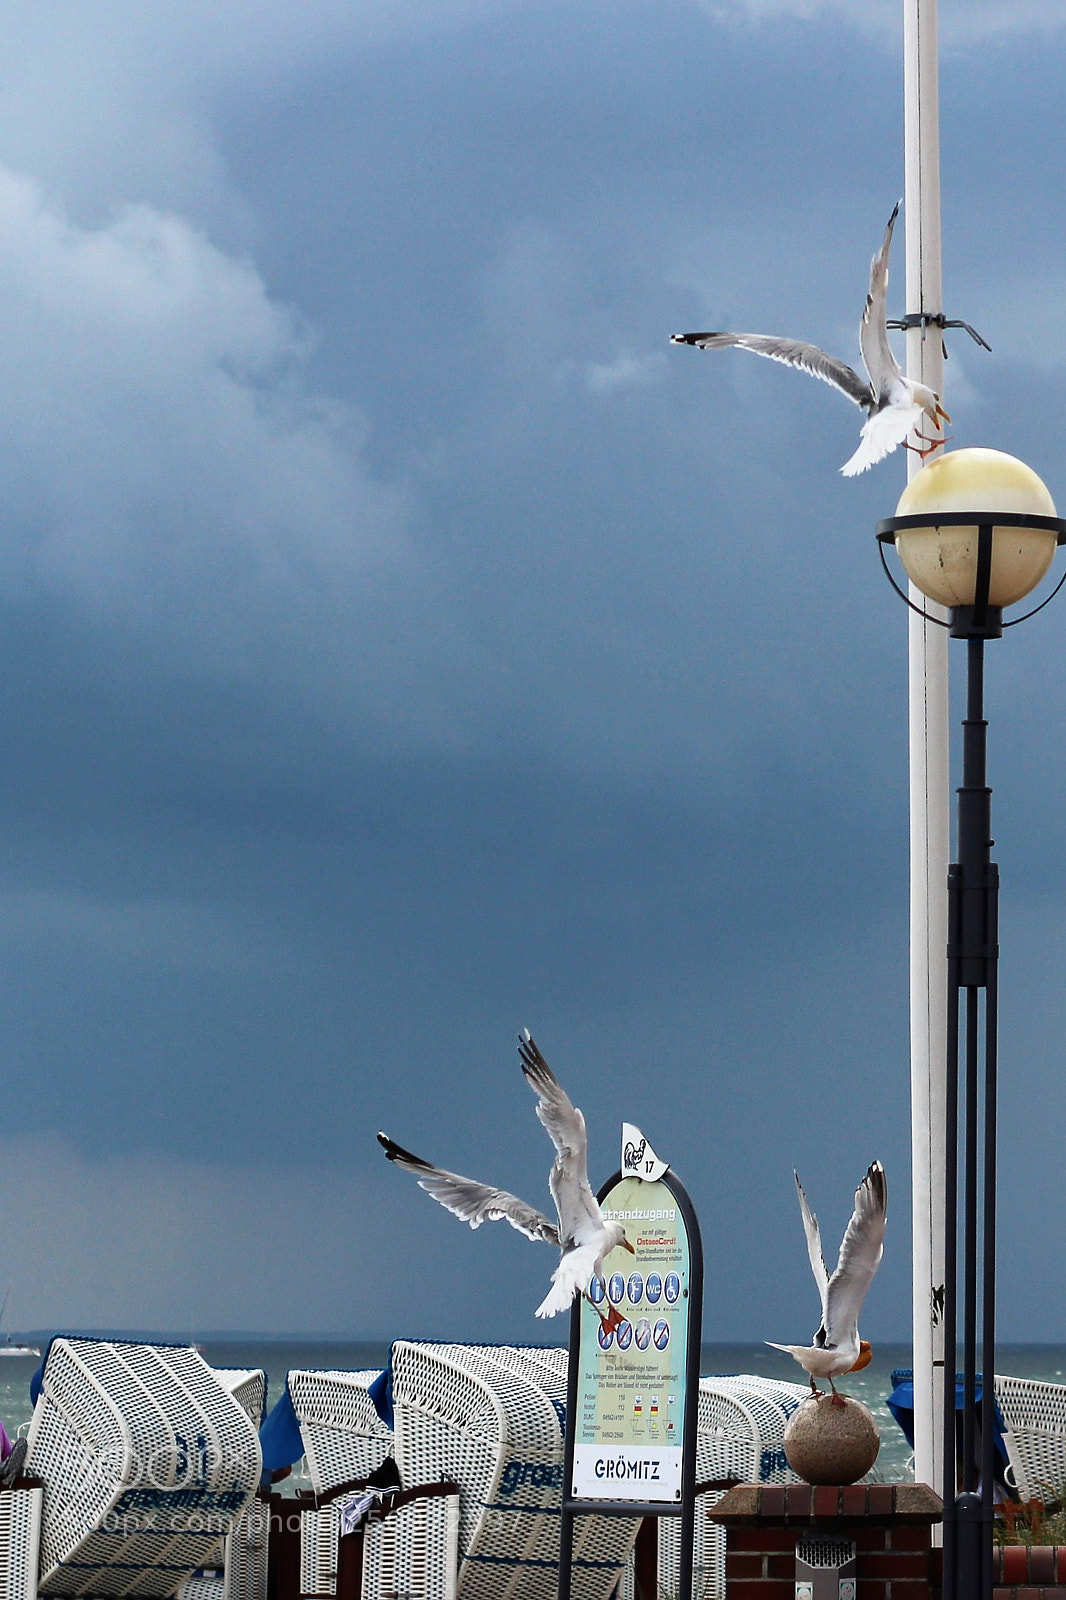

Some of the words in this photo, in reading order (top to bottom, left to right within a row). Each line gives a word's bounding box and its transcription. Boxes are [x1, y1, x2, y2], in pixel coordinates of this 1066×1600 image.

[645, 1160, 654, 1173] 17
[636, 1237, 677, 1245] OstseeCard!
[646, 1284, 661, 1294] WC
[594, 1454, 661, 1480] GRÖMITZ
